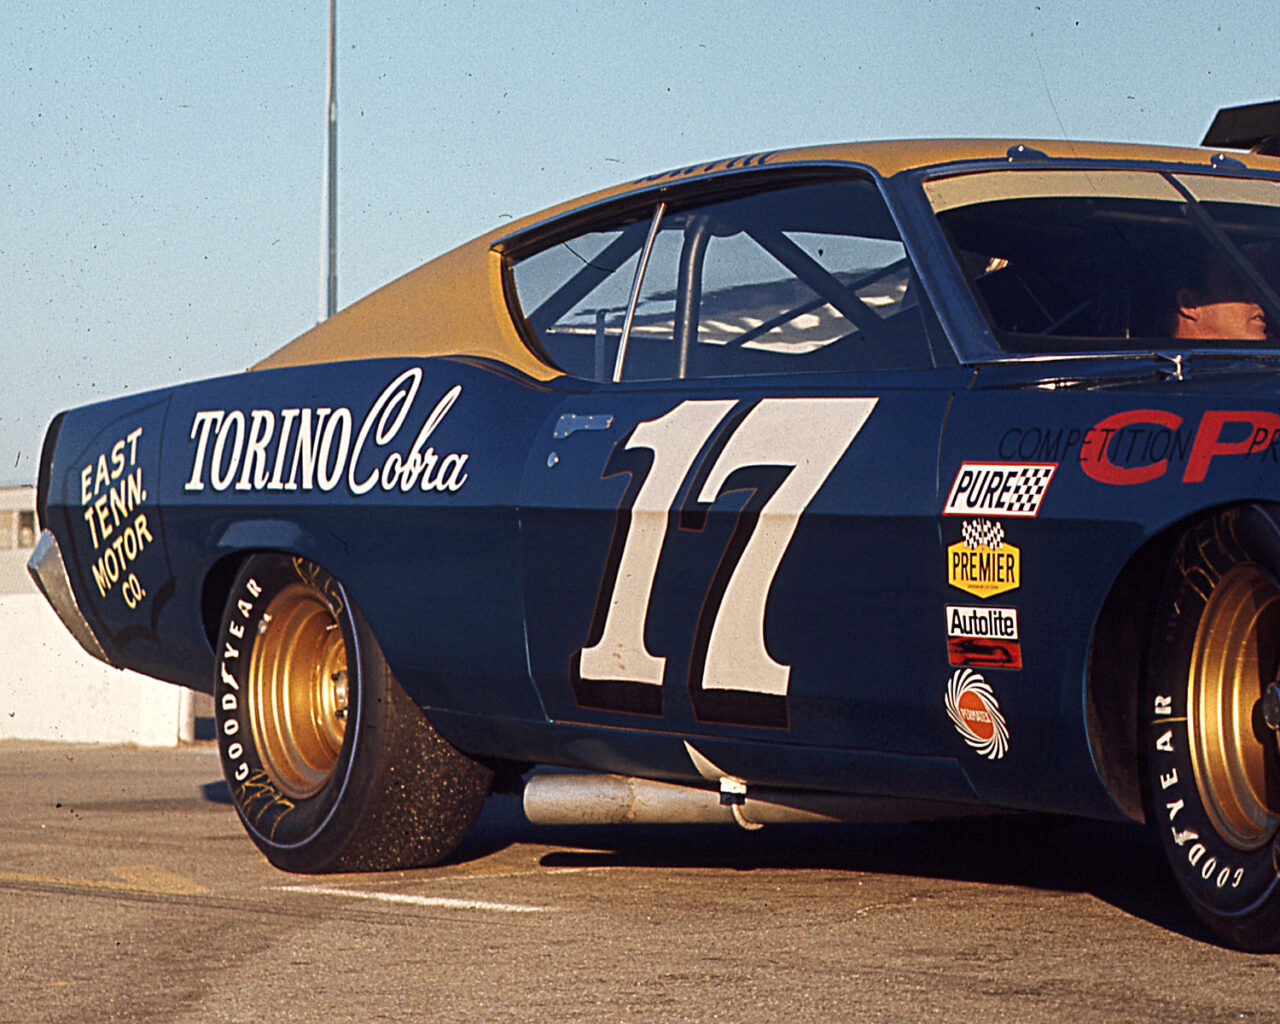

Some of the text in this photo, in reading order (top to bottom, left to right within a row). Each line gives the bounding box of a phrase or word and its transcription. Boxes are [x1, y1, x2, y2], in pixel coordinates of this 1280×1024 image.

[81, 426, 143, 506] EAST
[184, 367, 468, 495] TORINO Cobra
[1000, 426, 1194, 462] COMPETITION
[84, 466, 147, 550] TENN.
[948, 469, 1018, 509] PURE
[91, 513, 153, 598] MOTOR
[572, 396, 880, 697] 17
[952, 551, 1016, 584] PREMIER
[121, 572, 147, 610] CO.
[951, 608, 1015, 637] Autolite
[221, 577, 262, 781] GOODYEAR
[1154, 693, 1244, 888] GOODYEAR
